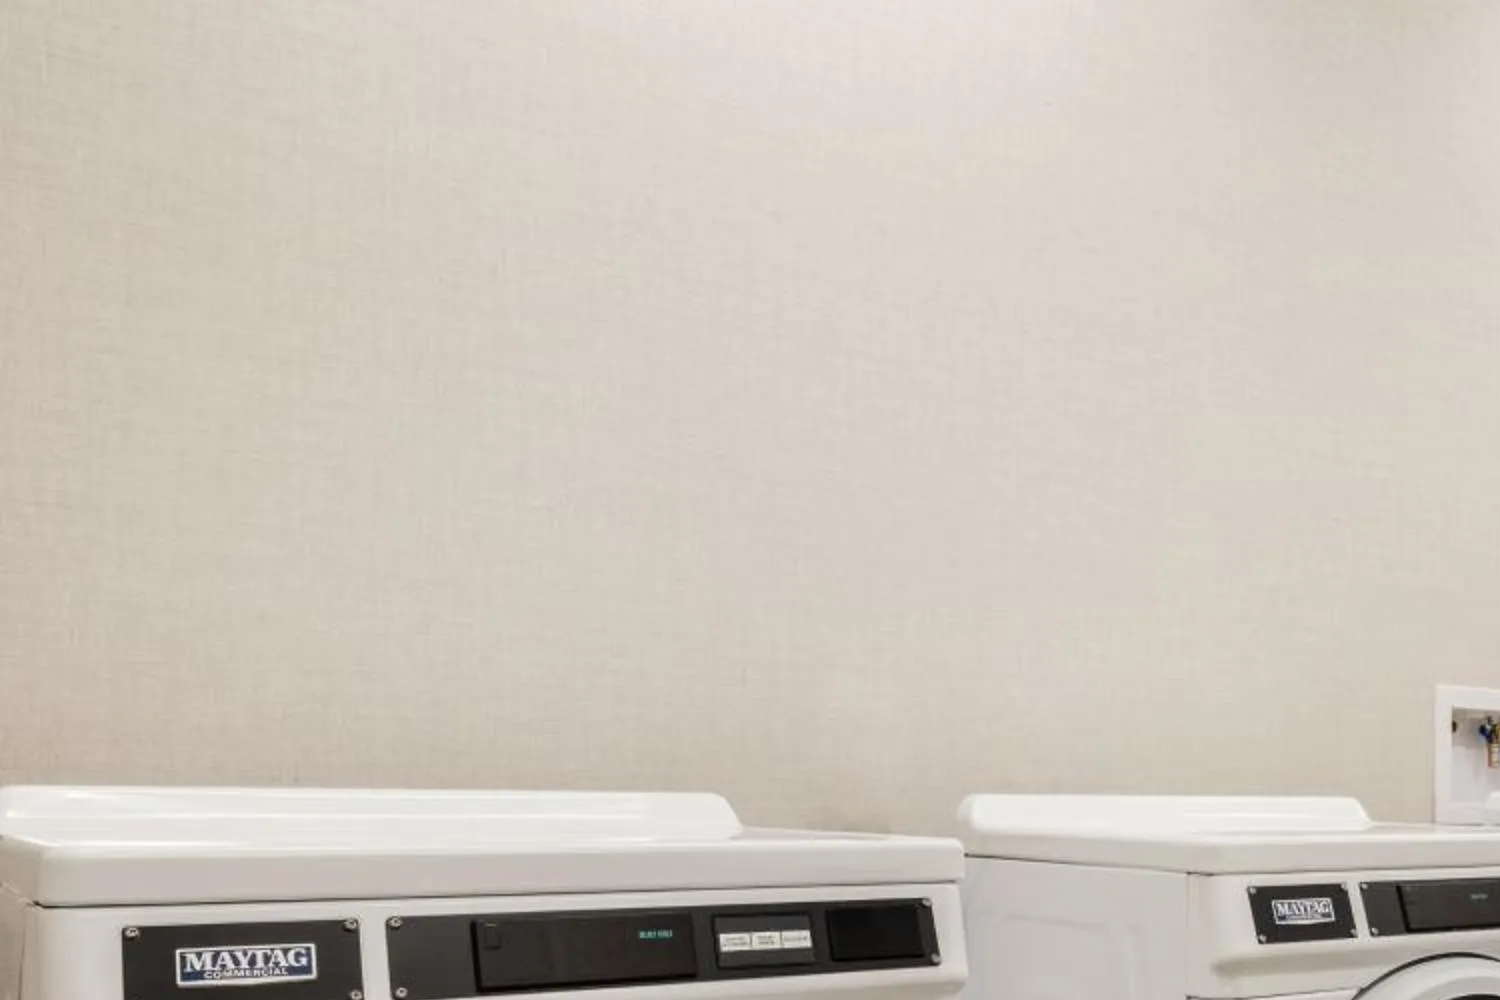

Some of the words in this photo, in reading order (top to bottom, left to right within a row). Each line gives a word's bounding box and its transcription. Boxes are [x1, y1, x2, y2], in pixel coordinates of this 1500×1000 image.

[1276, 901, 1330, 916] MAYTAG
[182, 948, 308, 972] MAYTAG
[203, 967, 288, 979] COMMERCIAL
